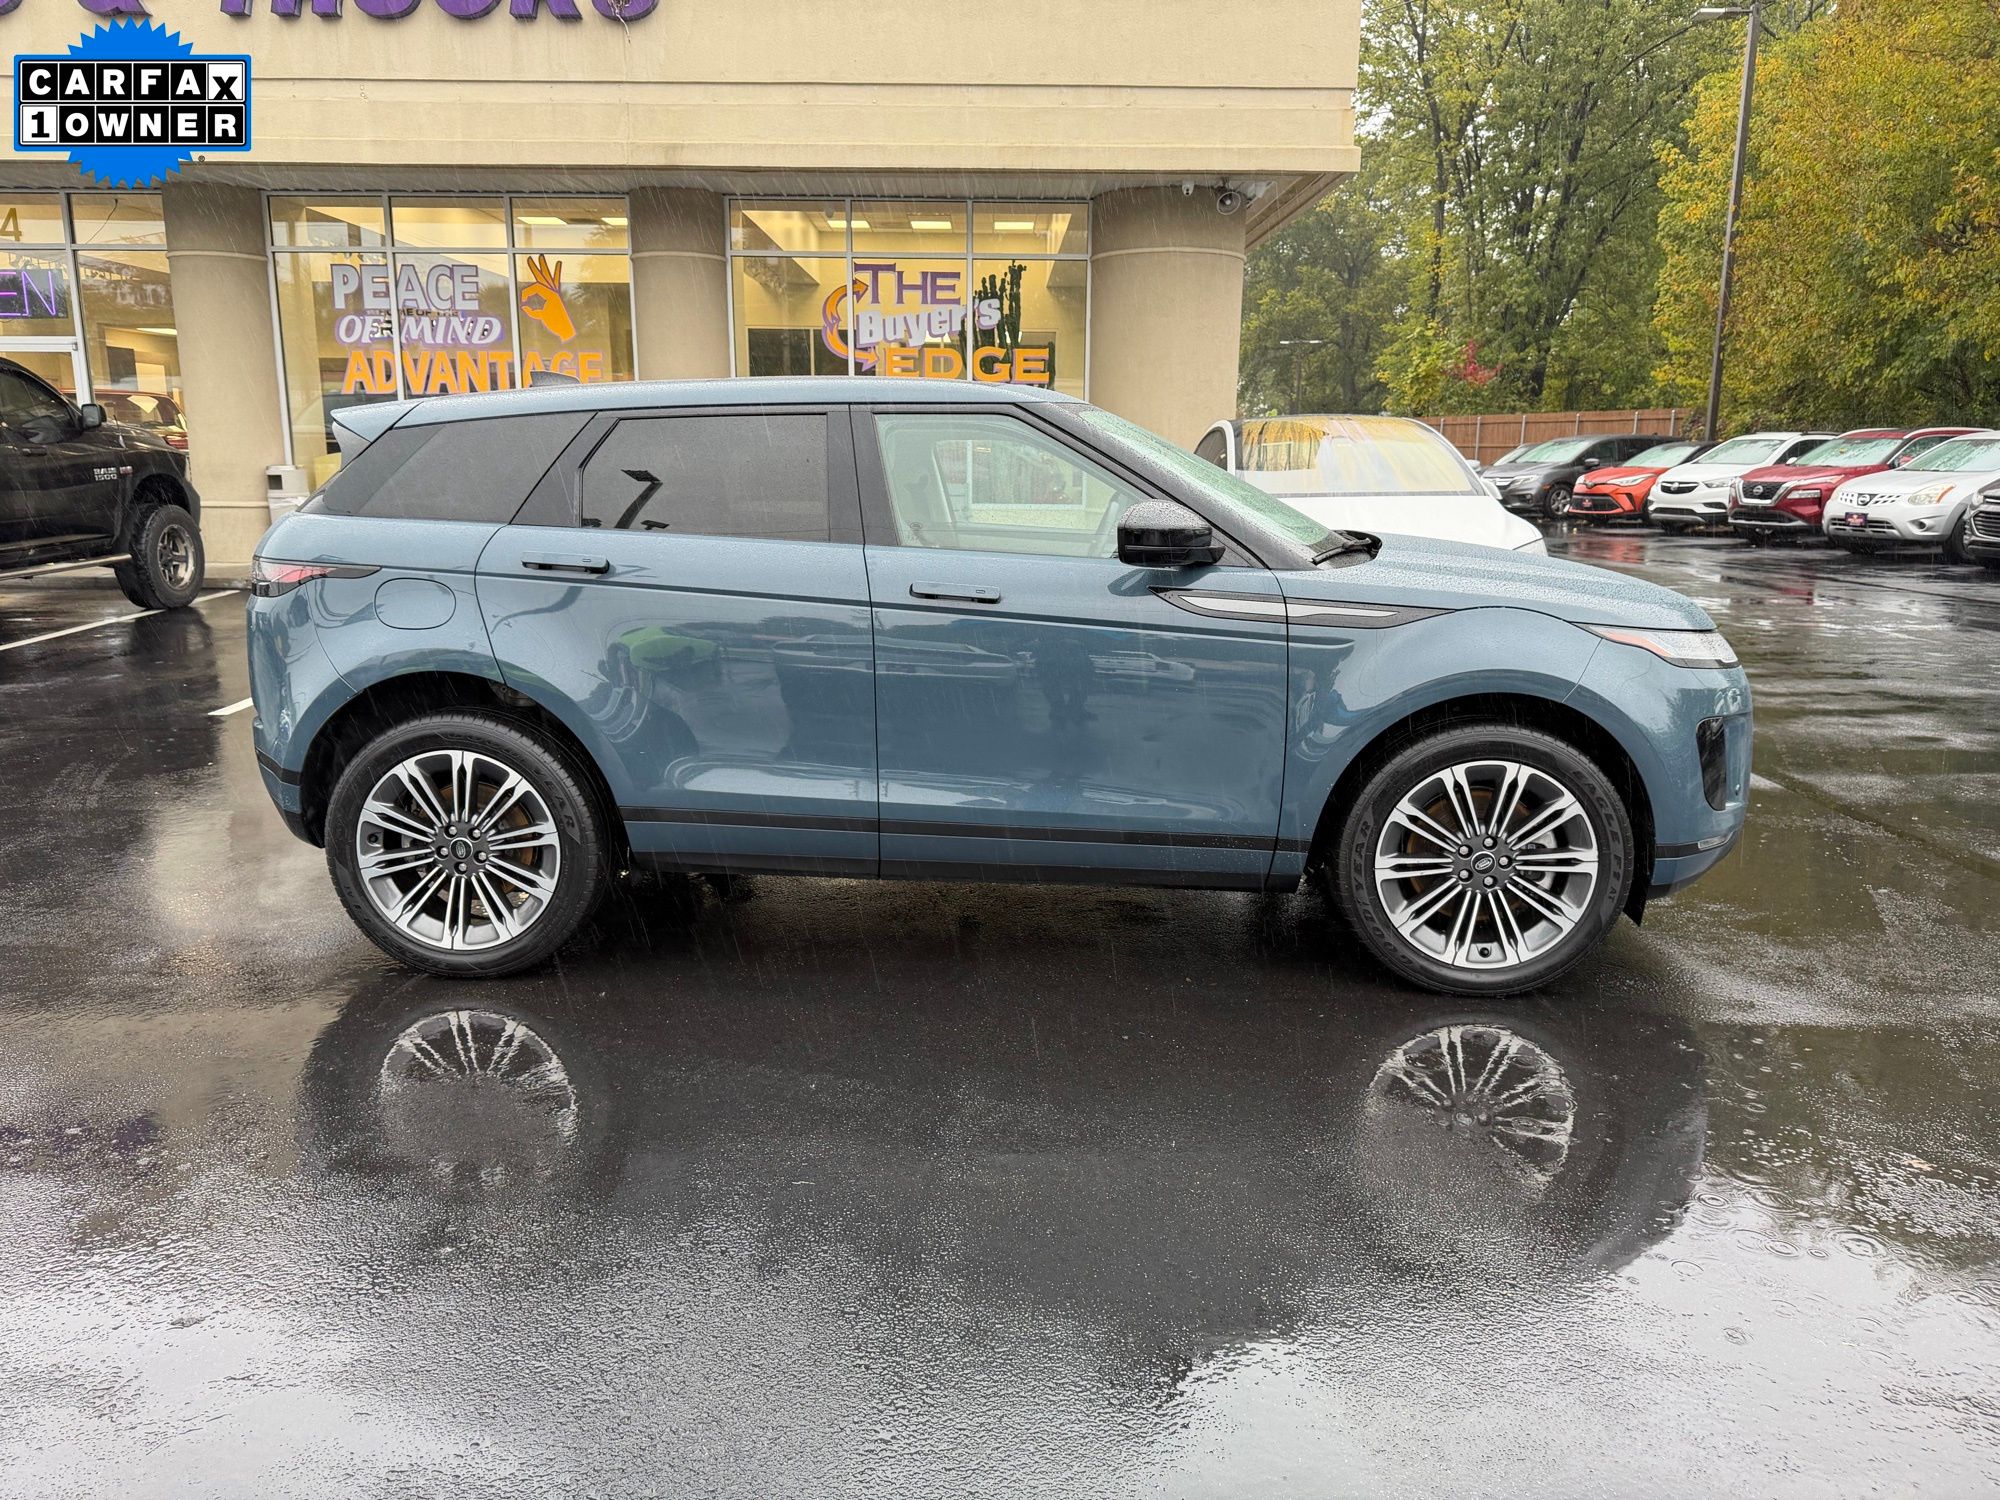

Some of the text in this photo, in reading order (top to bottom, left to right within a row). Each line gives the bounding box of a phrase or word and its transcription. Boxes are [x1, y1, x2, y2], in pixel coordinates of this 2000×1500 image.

[330, 263, 480, 311] PEACE
[854, 262, 961, 305] THE
[338, 314, 388, 344] OF
[400, 315, 501, 345] MIND
[856, 297, 1001, 347] Buyer's
[885, 346, 1050, 384] EDGE
[95, 473, 117, 481] 1500
[1572, 770, 1620, 845] EAGLE
[1353, 820, 1414, 966] GOODYEAR
